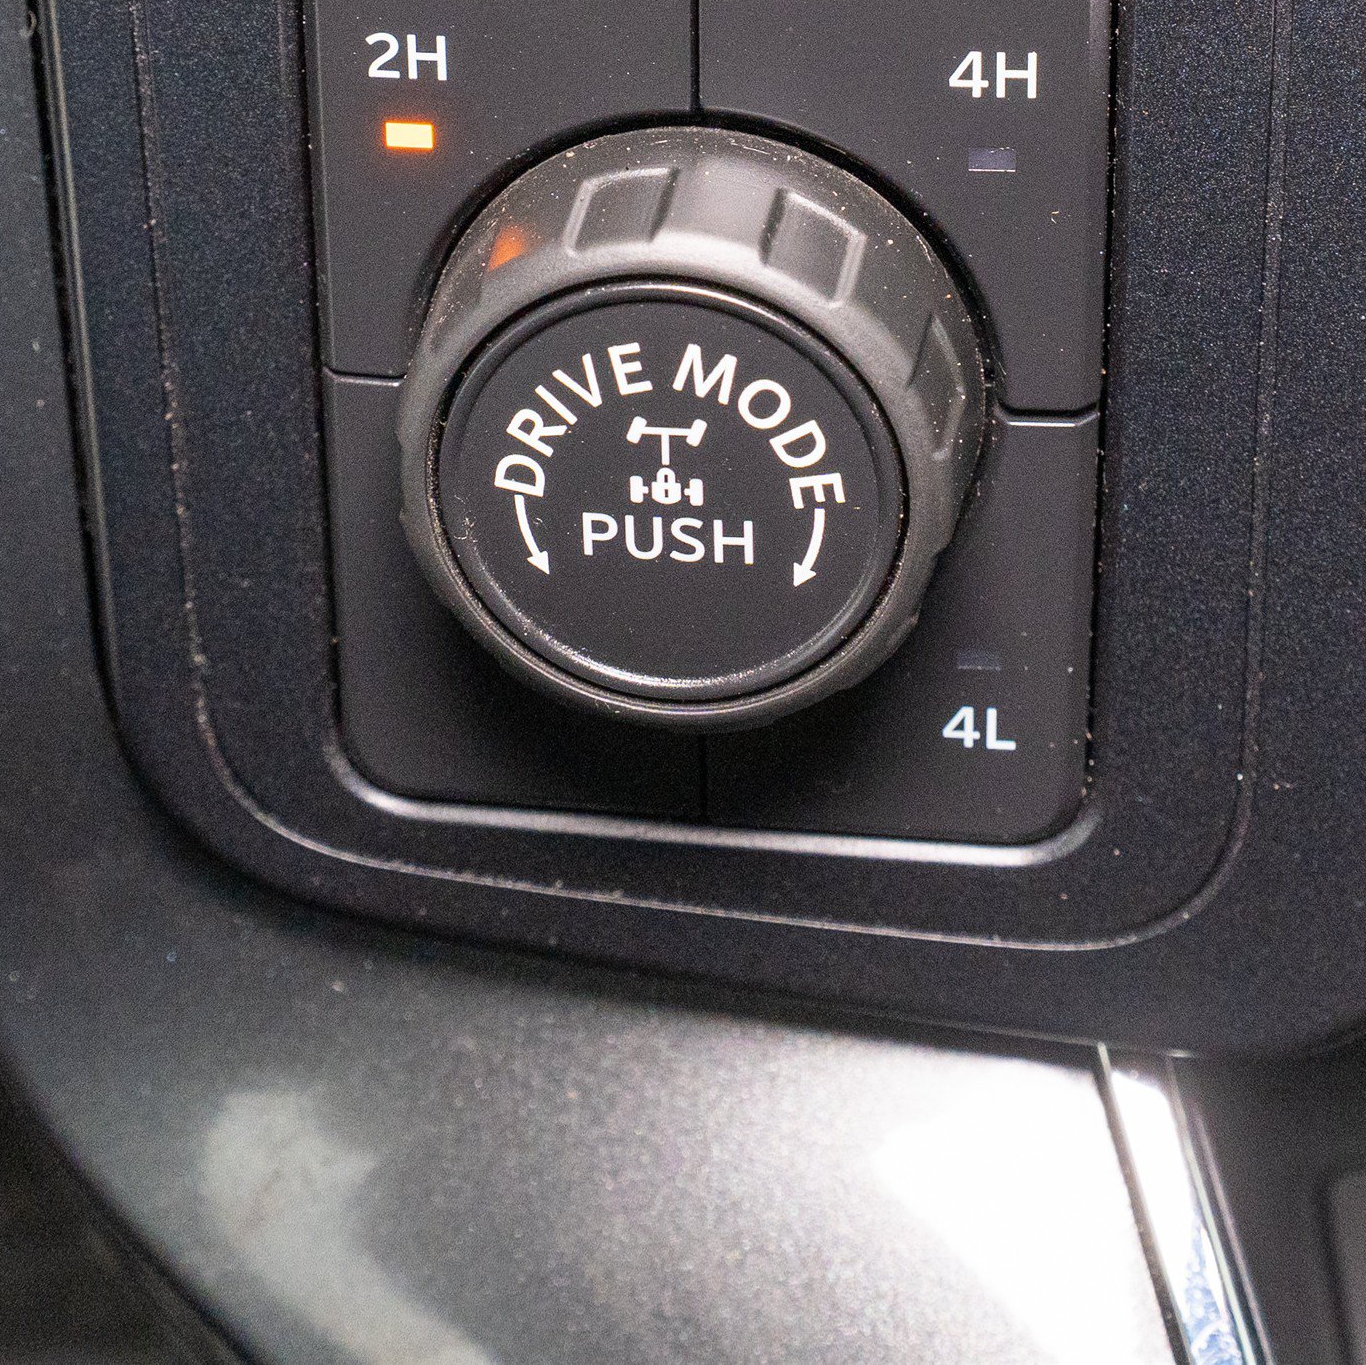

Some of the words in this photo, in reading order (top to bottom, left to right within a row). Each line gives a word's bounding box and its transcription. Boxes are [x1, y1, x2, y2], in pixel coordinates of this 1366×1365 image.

[365, 31, 448, 82] 2H
[948, 50, 1038, 100] 4H
[493, 341, 654, 498] DRIVE
[672, 343, 846, 510] MODE
[582, 511, 754, 565] PUSH
[942, 706, 1017, 751] 4L
